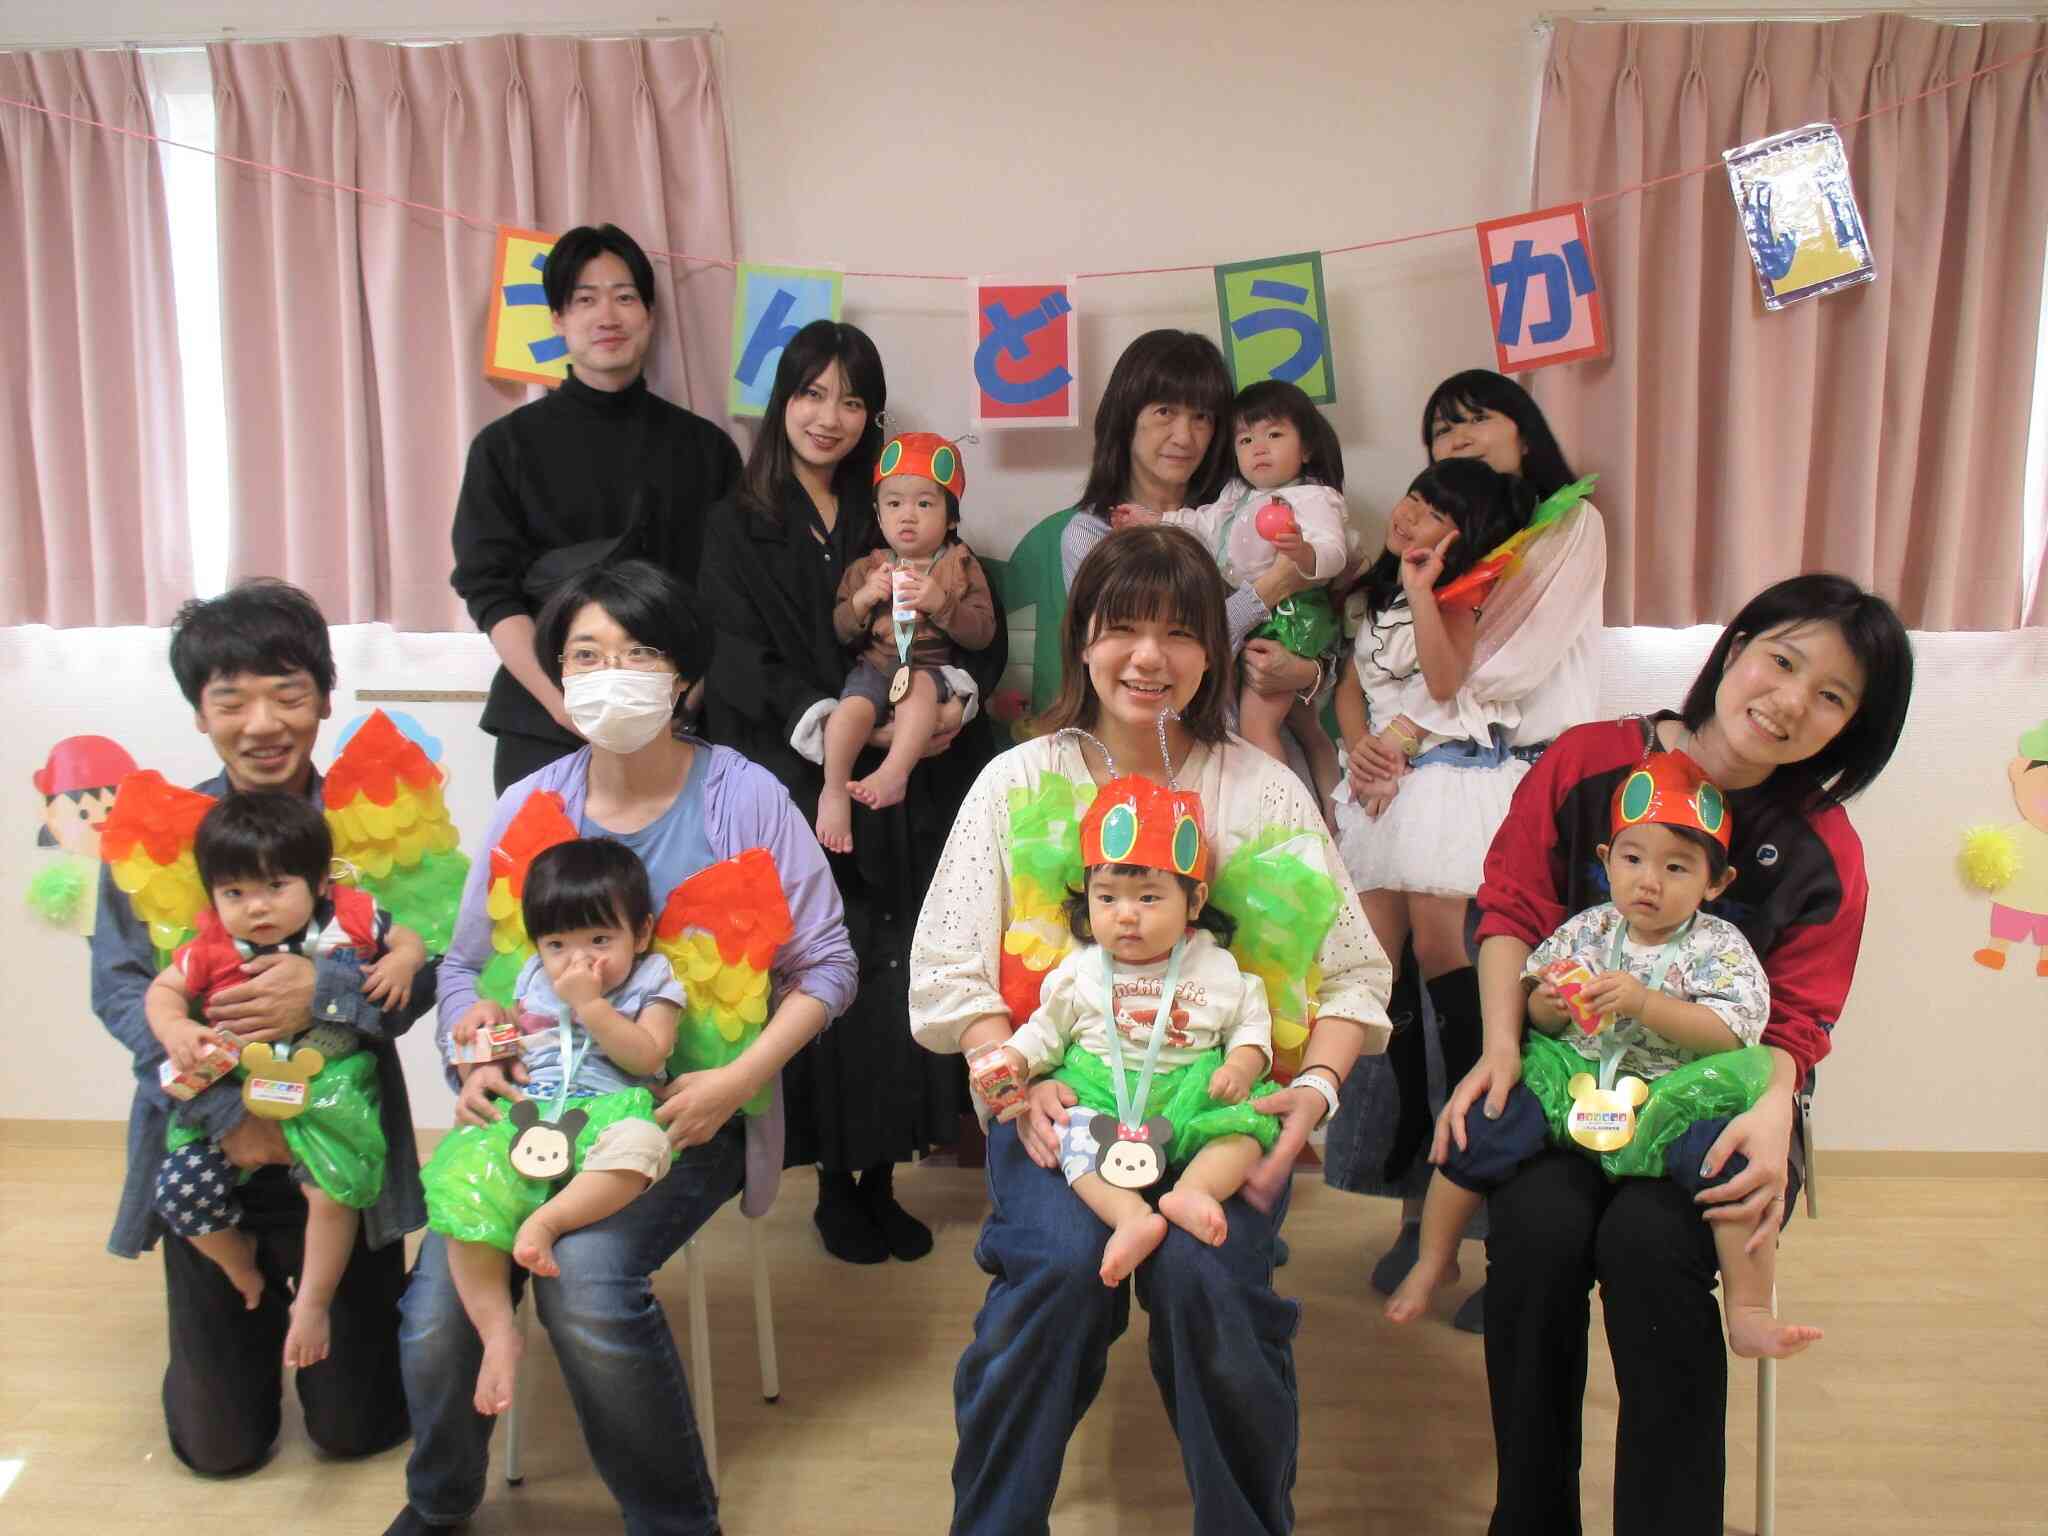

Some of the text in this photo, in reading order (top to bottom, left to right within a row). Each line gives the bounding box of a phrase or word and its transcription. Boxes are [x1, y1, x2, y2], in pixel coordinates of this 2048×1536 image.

[973, 291, 1074, 405] ど
[1231, 279, 1325, 383] う
[1489, 240, 1597, 346] か
